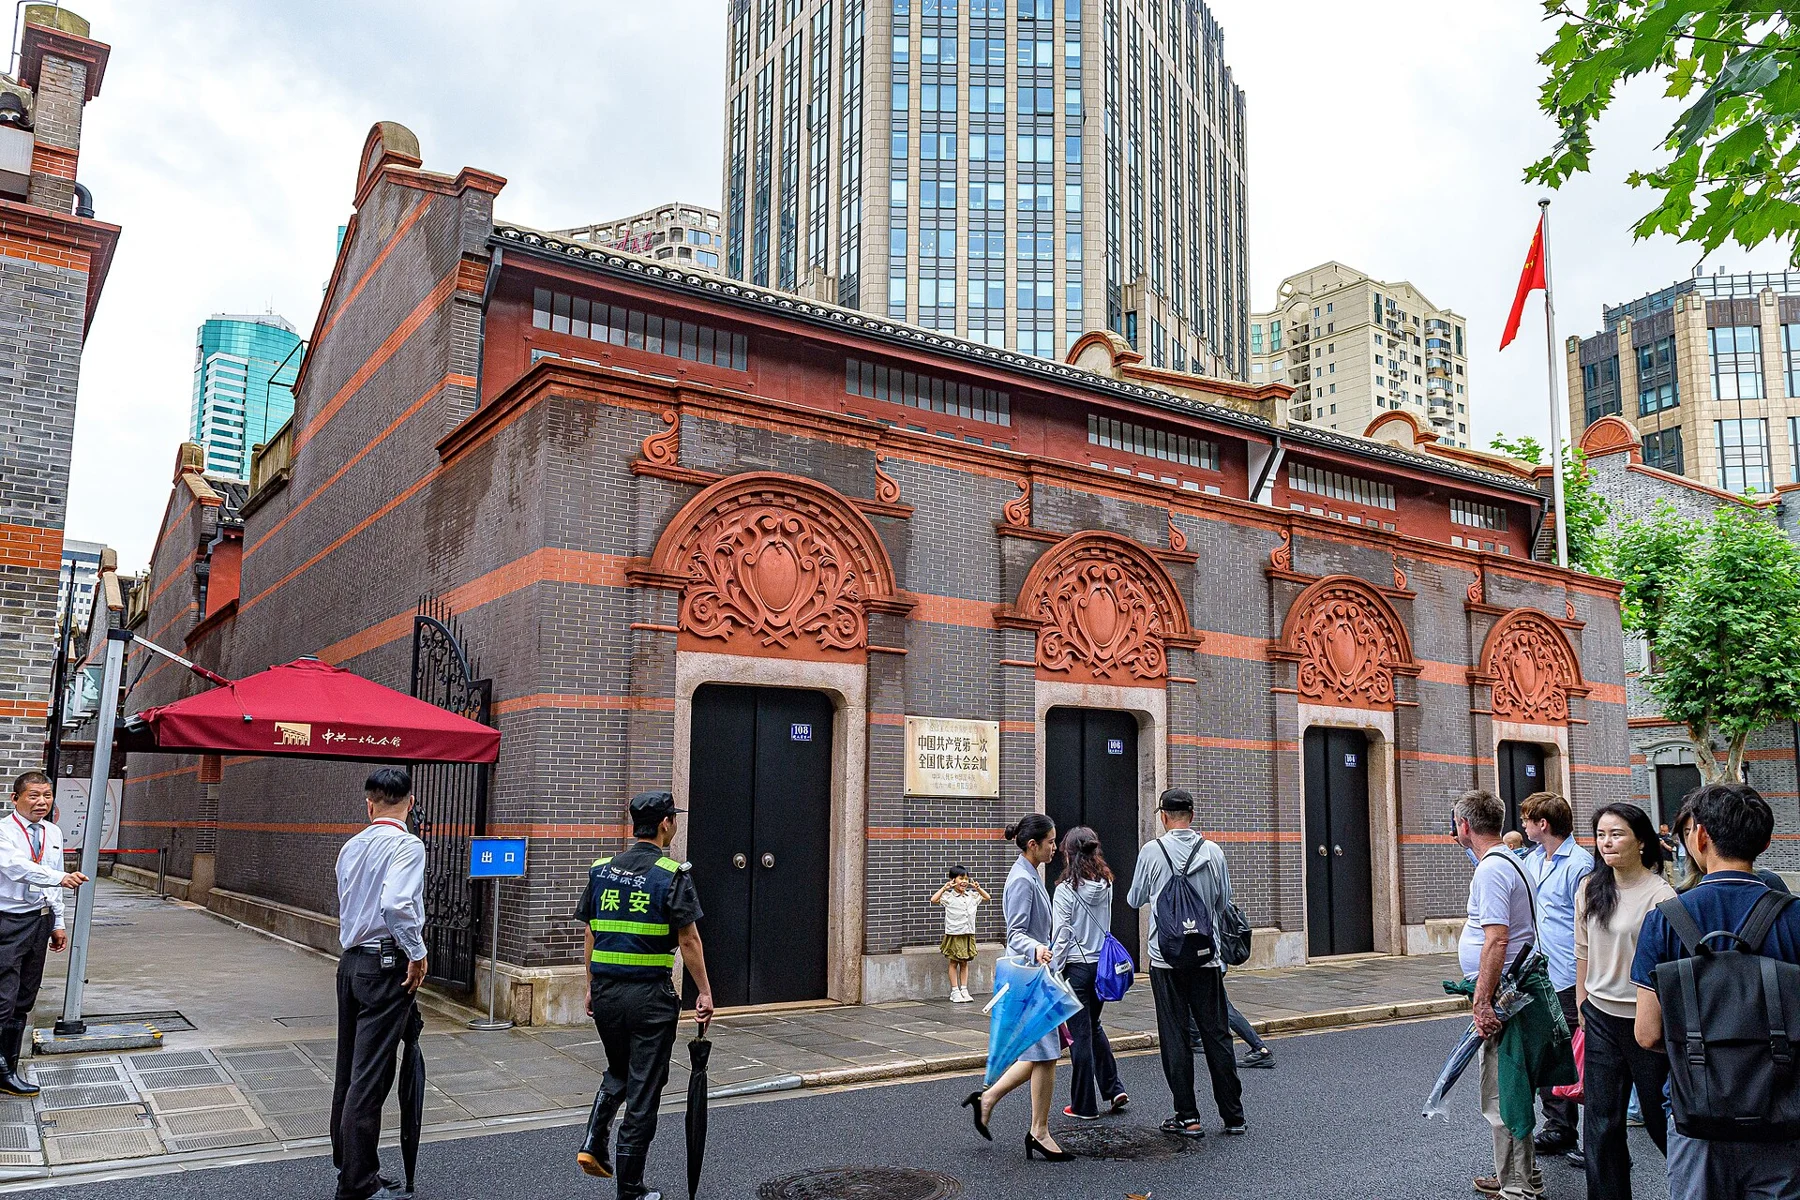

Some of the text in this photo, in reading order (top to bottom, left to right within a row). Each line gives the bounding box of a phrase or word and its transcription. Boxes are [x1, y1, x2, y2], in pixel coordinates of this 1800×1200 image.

[794, 725, 809, 735] 108
[918, 734, 988, 753] 中国共产党第一次
[918, 753, 988, 772] 全国代表大会会址
[481, 850, 515, 864] 出口
[600, 888, 651, 914] 保安
